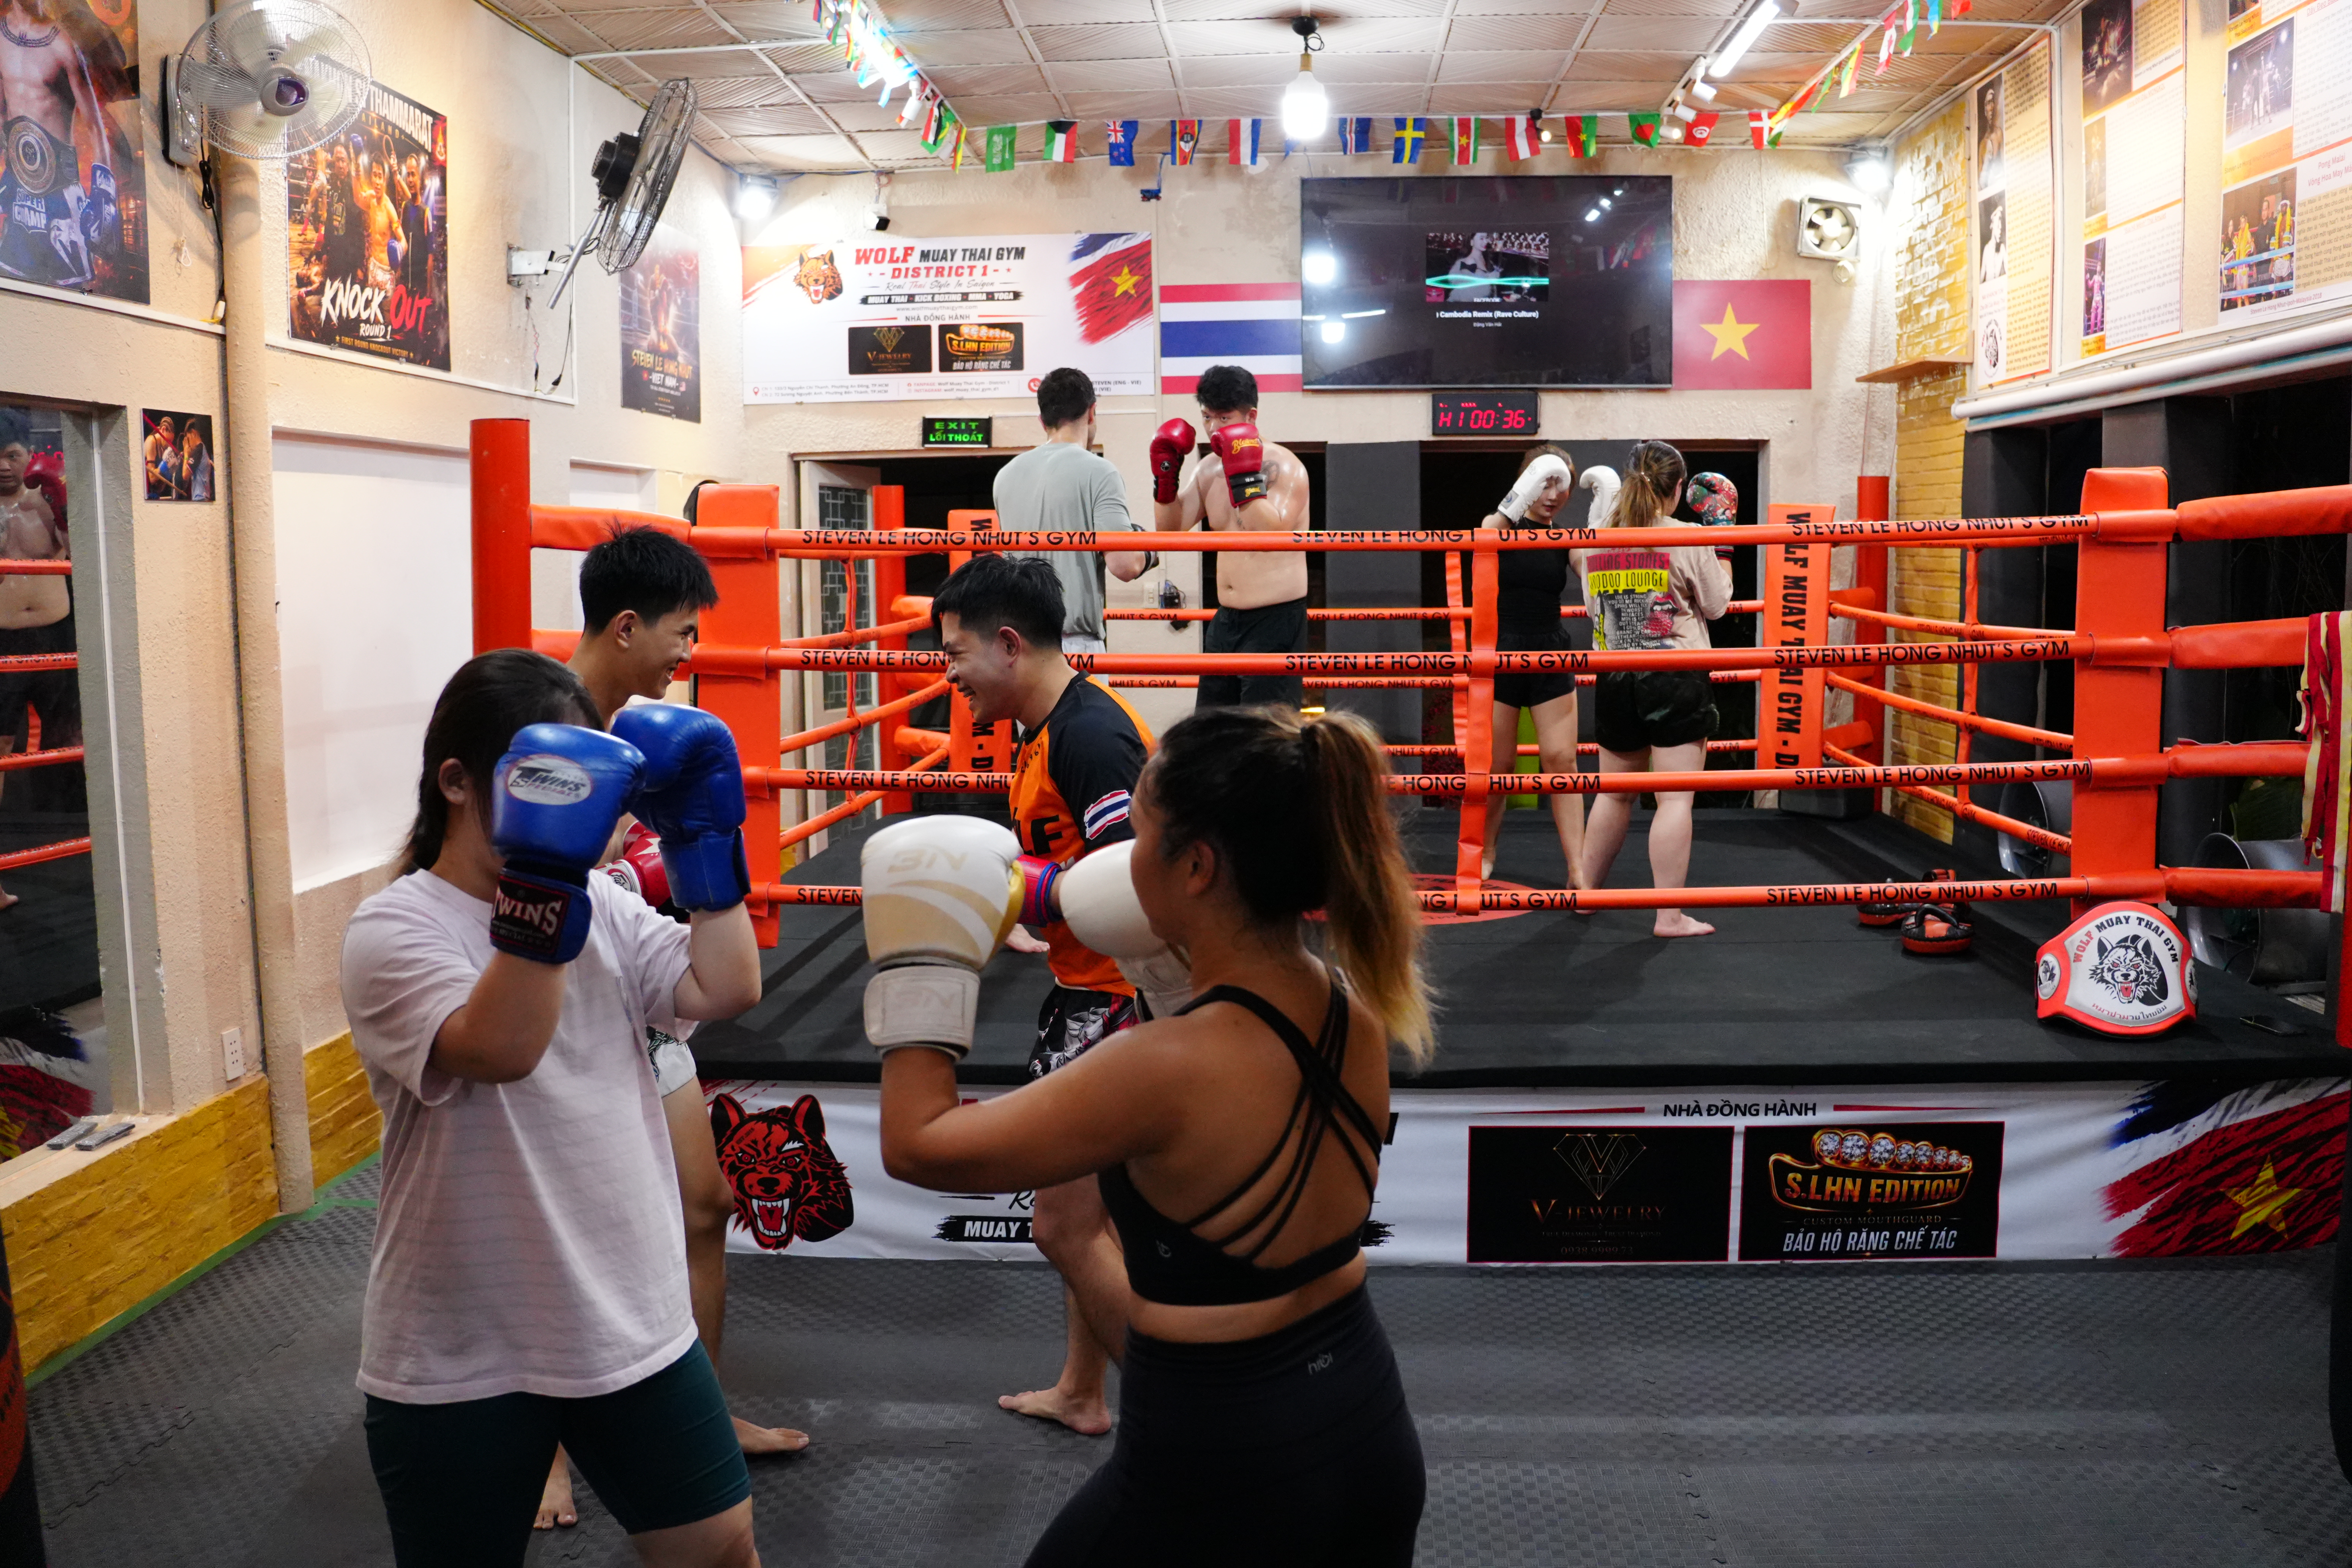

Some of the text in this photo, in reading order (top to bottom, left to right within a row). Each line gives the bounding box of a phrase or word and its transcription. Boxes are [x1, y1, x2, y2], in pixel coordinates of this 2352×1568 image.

[370, 85, 433, 153] THAMMARAT
[2318, 153, 2345, 169] Pong Malai
[2308, 169, 2344, 187] Vòng Hoa May
[855, 247, 1026, 265] WOLF MUAY THAI GYM
[891, 265, 988, 279] DISTRICT 1
[885, 280, 995, 291] Real Thai Style In Saigon
[320, 273, 386, 327] KNOCK
[906, 313, 921, 322] NHÀ
[360, 323, 385, 337] ROUND
[342, 336, 354, 346] FIRST
[952, 340, 1010, 352] S.LHN EDITION
[1470, 409, 1525, 429] 00:36
[929, 430, 984, 442] LỐI THOÁT
[1792, 515, 2088, 536] STEVEN LE HONG NHUT'S GYM
[802, 530, 1097, 545] STEVEN LE HONG NHUT'S GYM
[1292, 528, 1596, 543] STEVEN LE HONG GYM
[1626, 553, 1666, 569] STONES
[1626, 572, 1663, 587] LOUNGE
[801, 651, 895, 666] STEVEN LE
[1774, 640, 2069, 665] STEVEN LE HONG NHUT'S GYM
[1776, 575, 1807, 735] MUAY GYM
[1285, 653, 1589, 670] STEVEN LE HONG GYM
[805, 771, 969, 789] STEVEN LE HONG
[1794, 761, 2090, 786] STEVEN LE HONG NHUT'S GYM
[1403, 775, 1600, 791] HONG GYM
[797, 888, 862, 904] STEVEN
[1528, 892, 1577, 908] GYM
[1767, 880, 2058, 904] STEVEN LE HONG NHUT'S GYM
[2073, 915, 2179, 963] WOLF MUAY THAI GYM
[1663, 1099, 1817, 1117] NHÀ ĐỒNG HÀNH
[1785, 1172, 1960, 1203] S.LHN EDITION
[1528, 1198, 1668, 1224] V-JEWELRY
[1804, 1215, 1942, 1226] CUSTOM MOUTHGUARD
[964, 1221, 1021, 1238] MUAY
[1783, 1224, 1958, 1254] BẢO HỘ RĂNG CHẾ TÁC
